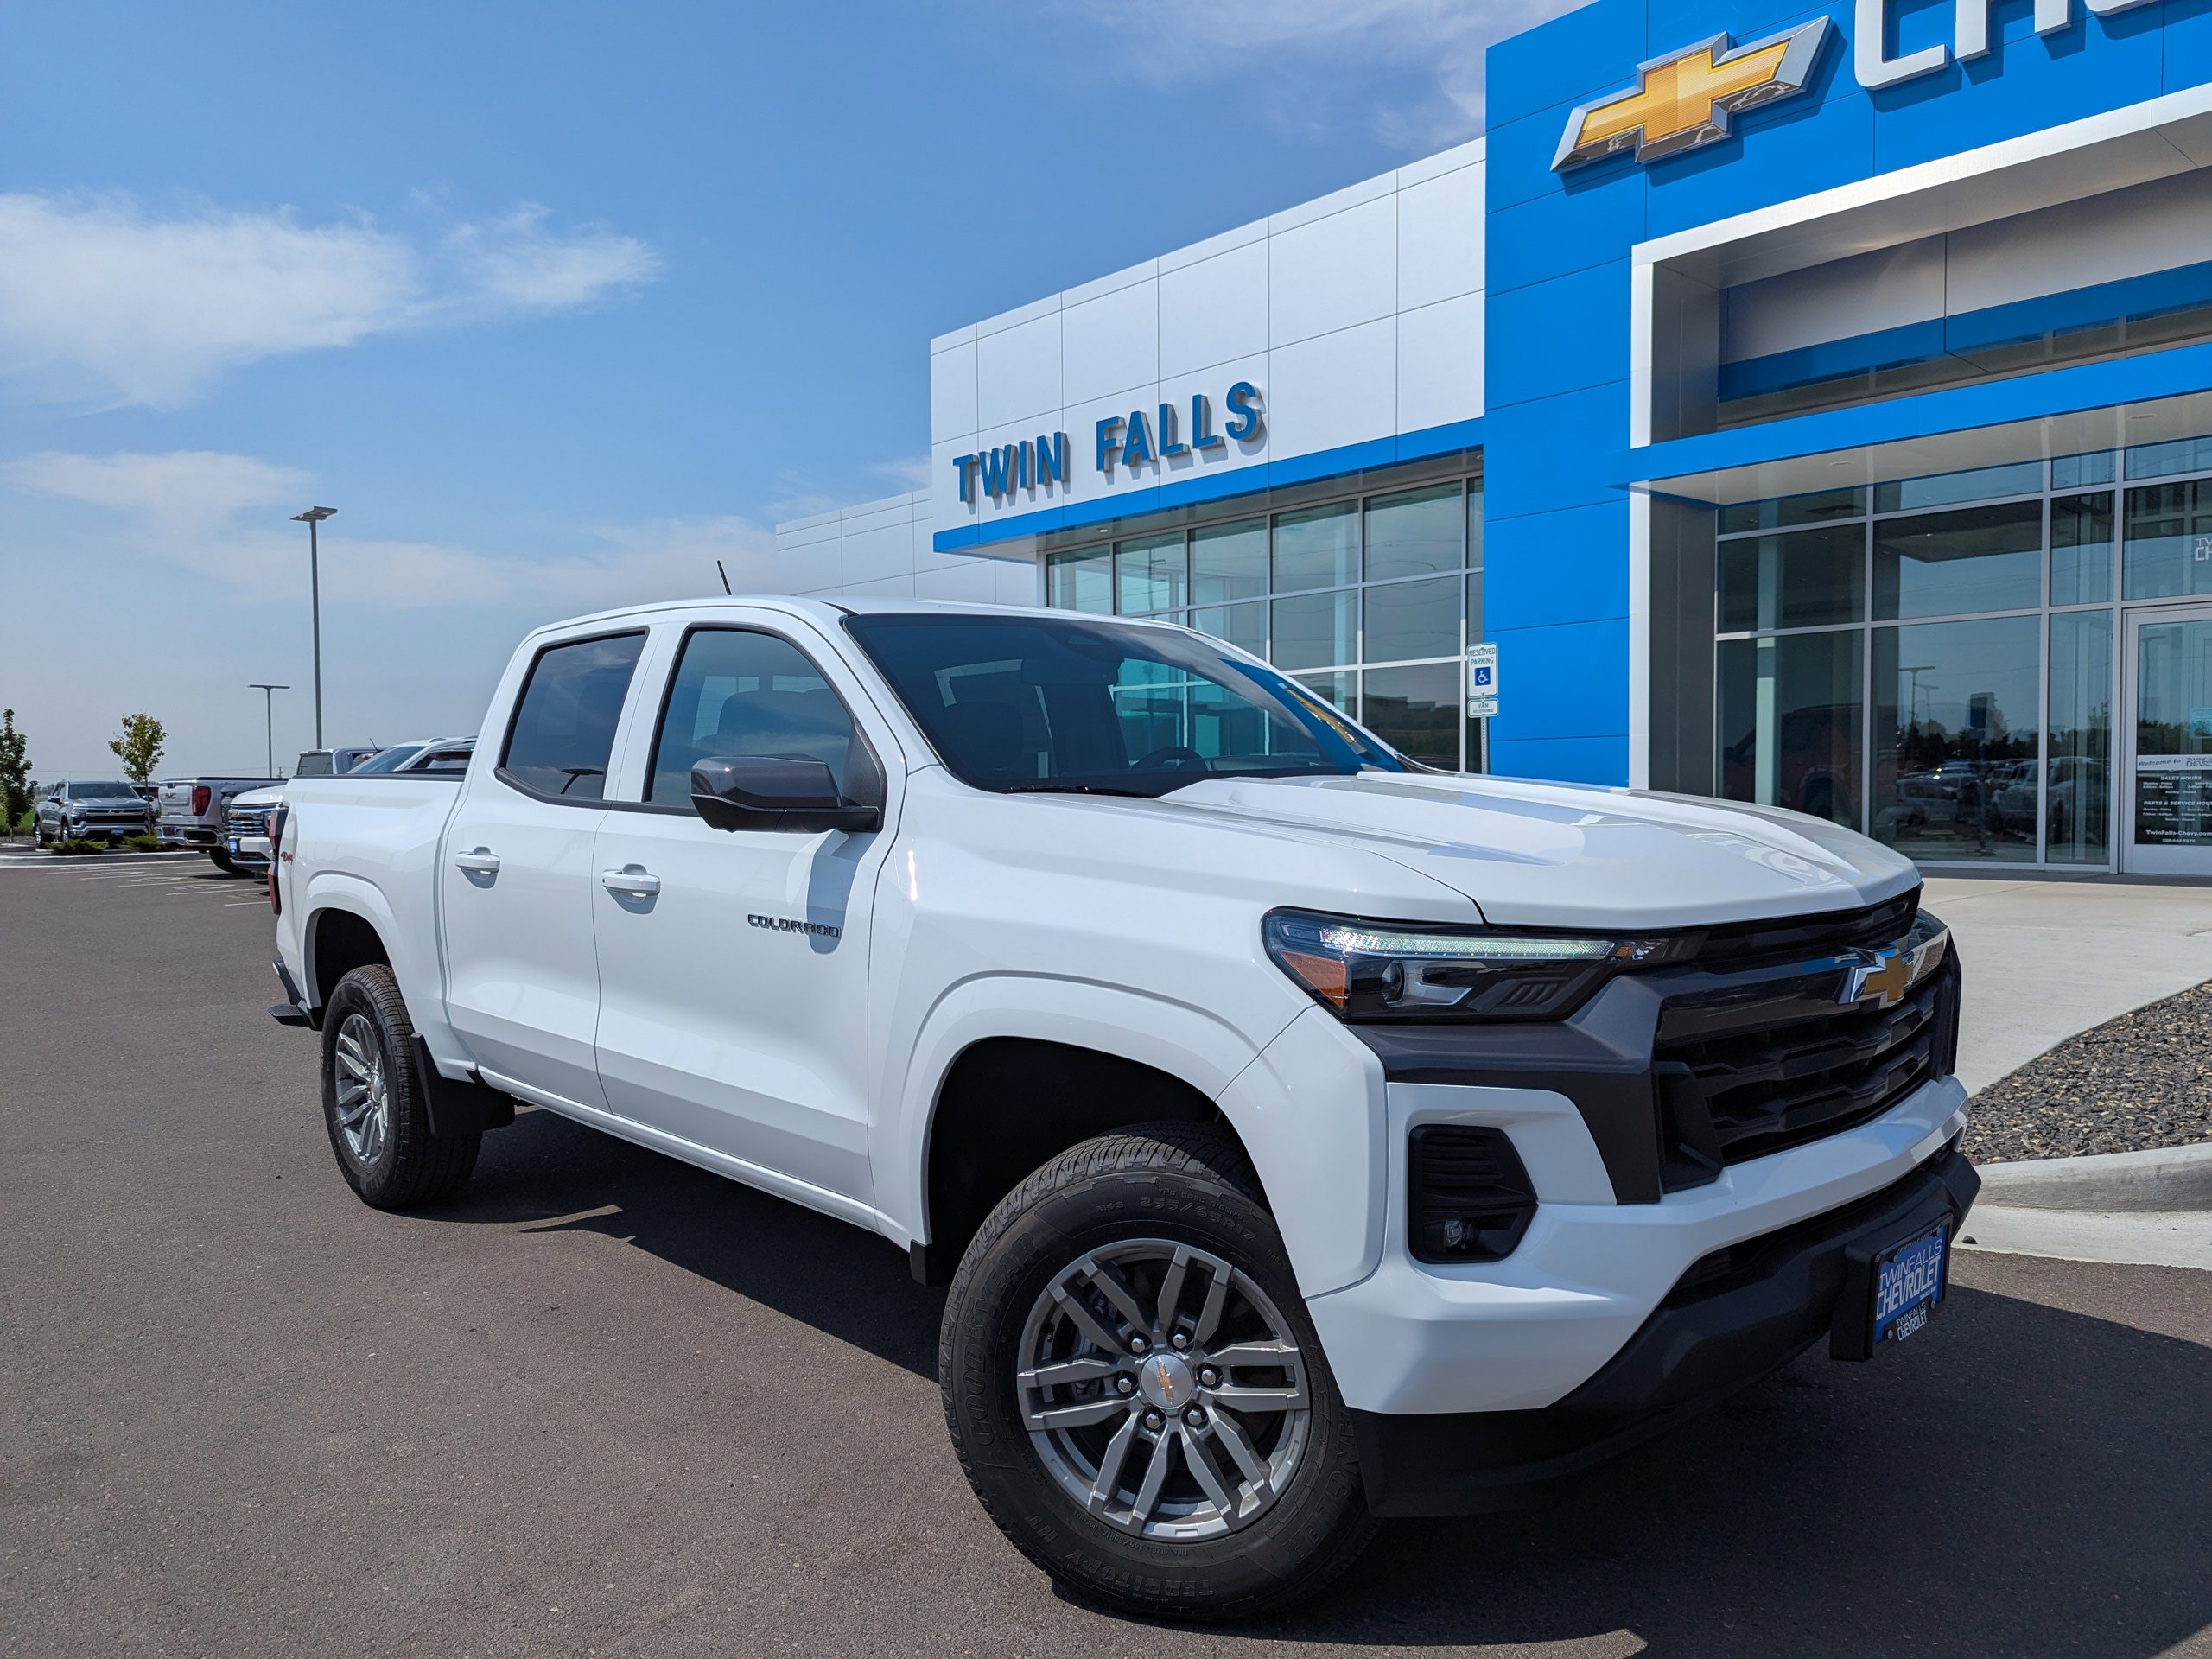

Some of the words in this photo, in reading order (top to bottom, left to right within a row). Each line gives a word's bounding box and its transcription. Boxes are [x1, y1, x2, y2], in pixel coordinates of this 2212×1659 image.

[953, 431, 1065, 503] TWIN
[1096, 381, 1262, 472] FALLS
[1469, 647, 1496, 657] RESERVED
[1471, 657, 1494, 665] PARKING
[747, 913, 842, 939] COLORADO
[1140, 1195, 1257, 1241] 255/65R17
[1876, 1255, 1942, 1321] CHEVROLET
[1897, 1308, 1928, 1341] CHEVROLET
[1064, 1548, 1214, 1598] TERRITORY
